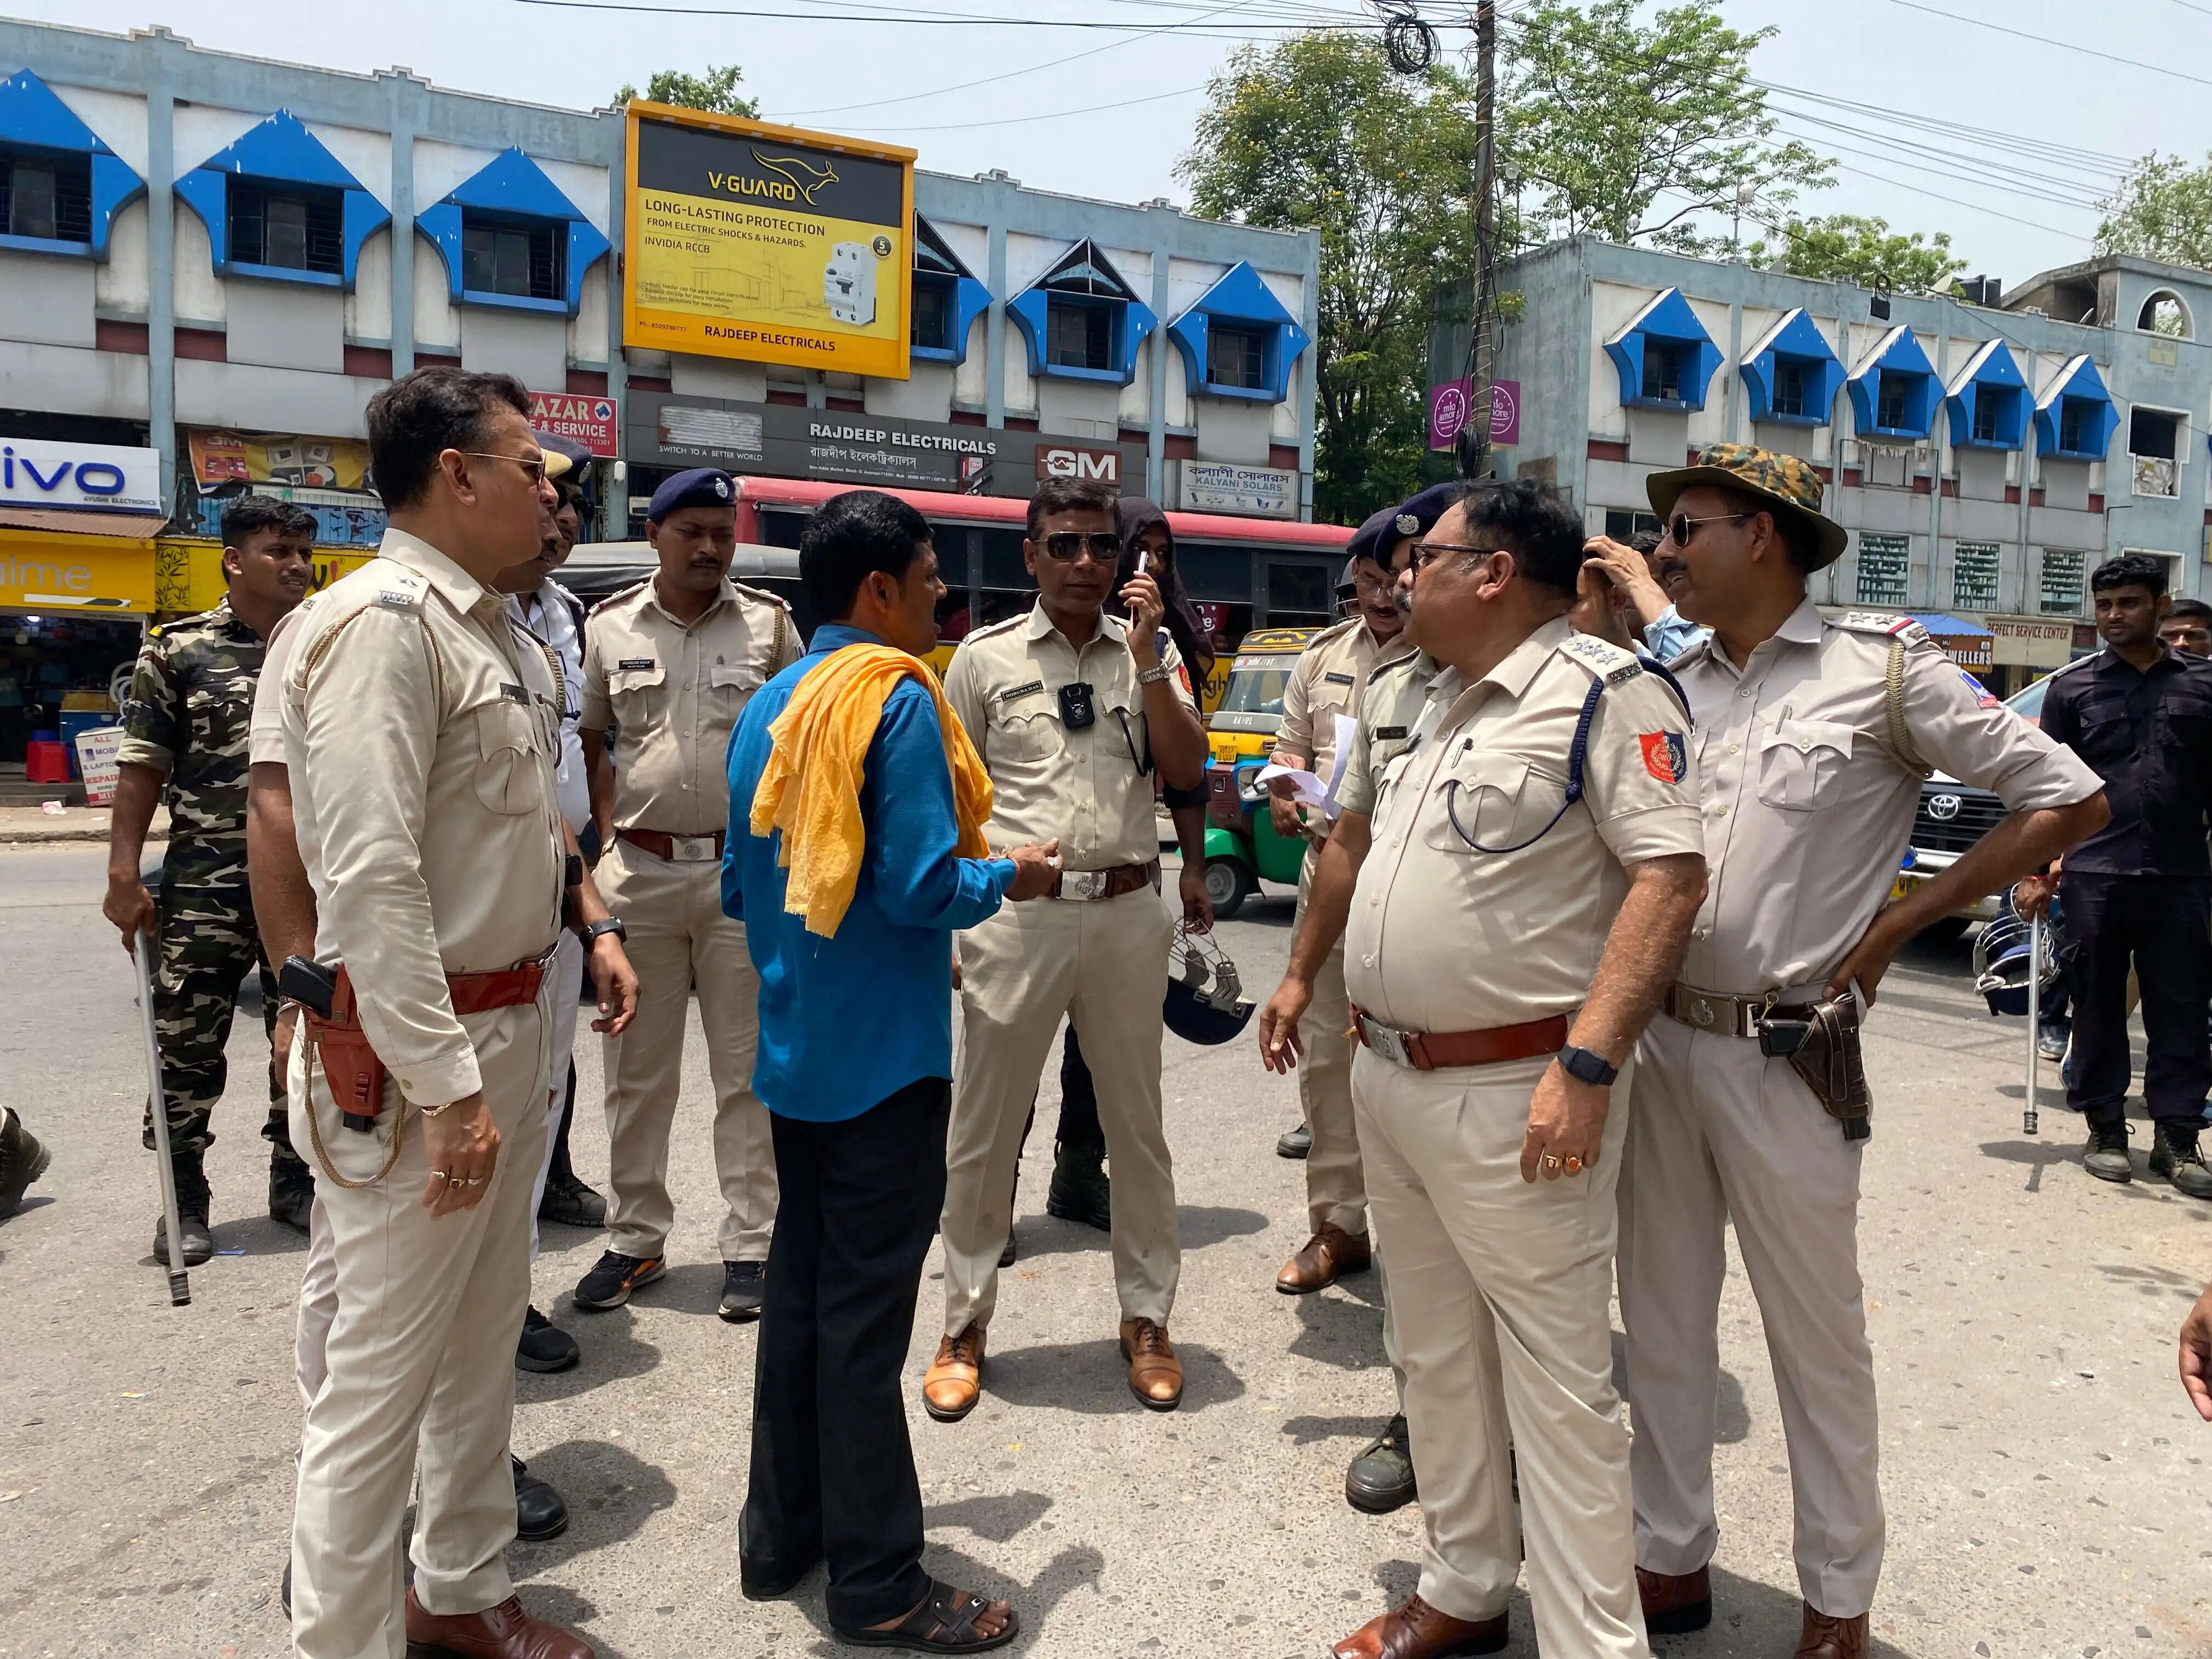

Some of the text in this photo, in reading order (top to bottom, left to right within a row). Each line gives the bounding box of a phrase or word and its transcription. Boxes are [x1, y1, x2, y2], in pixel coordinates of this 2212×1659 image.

[708, 171, 796, 202] V-GUARD
[645, 199, 825, 236] LONG-LASTING PROTECTION
[647, 217, 673, 229] FROM
[675, 222, 716, 235] ELECTRIC
[718, 228, 753, 241] SHOCKS
[645, 236, 710, 253] INVIDIA RCCB
[879, 240, 885, 249] 5
[704, 325, 836, 352] RAJDEEP ELECTRICALS
[530, 396, 589, 421] AZAR
[1492, 409, 1508, 418] ore
[553, 421, 606, 437] SERVICE
[809, 423, 996, 455] RAJDEEP ELECTRICALS
[659, 445, 687, 454] SWITCH
[712, 450, 735, 459] BETTER
[737, 453, 763, 461] WORLD
[809, 445, 848, 463] রাজদীপ
[1044, 449, 1116, 481] GM
[1188, 466, 1234, 478] কল্যাণী
[1196, 476, 1239, 488] KALYANI
[1243, 481, 1283, 492] SOLARS
[111, 497, 156, 506] ELECTRONICS
[1987, 623, 2069, 640] PERFECT SERVICE CENTER
[1944, 650, 1993, 665] WELLERS
[1006, 684, 1040, 698] DHRUBA DAS
[90, 761, 115, 770] LAPTO
